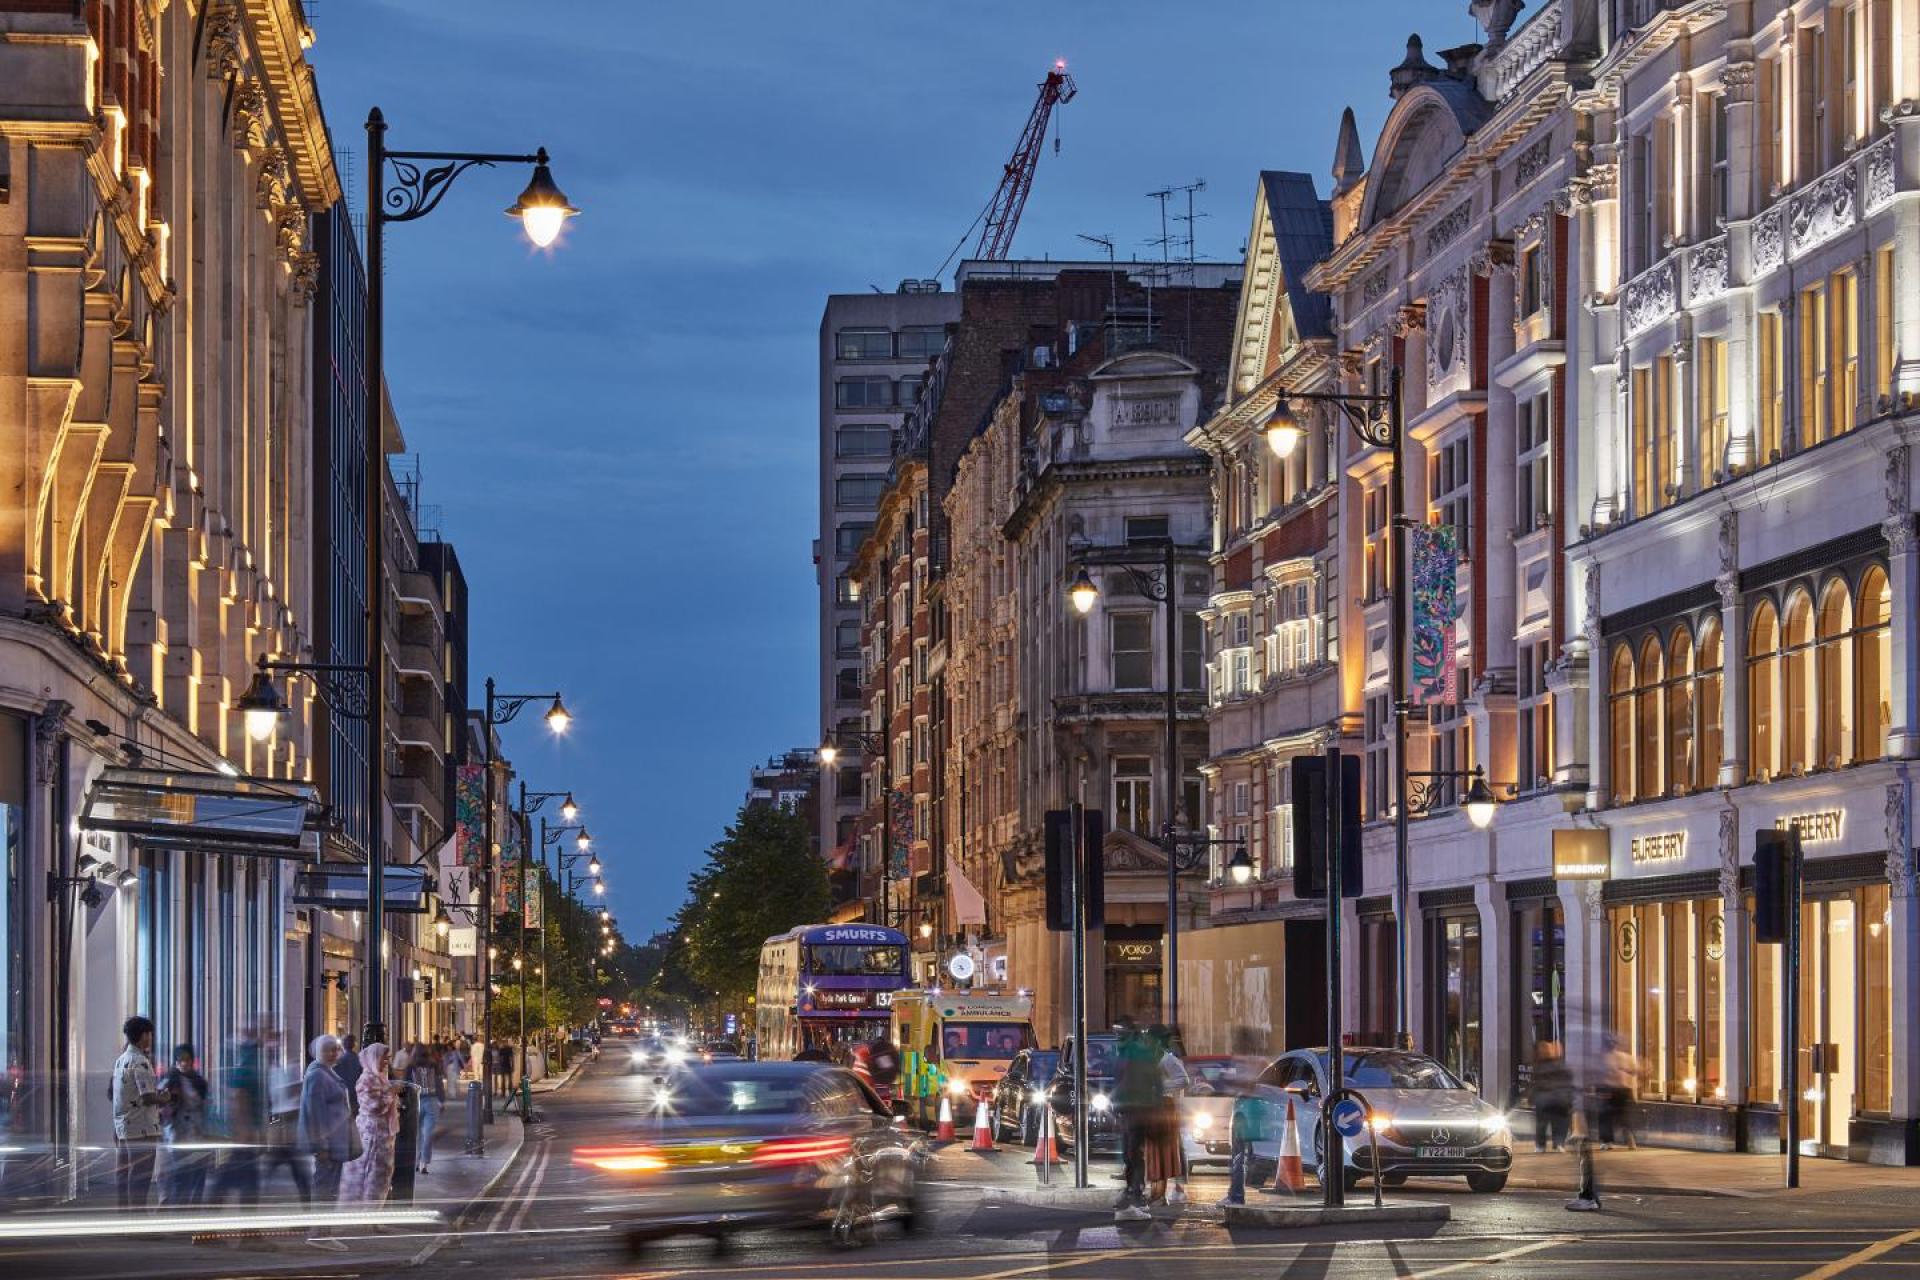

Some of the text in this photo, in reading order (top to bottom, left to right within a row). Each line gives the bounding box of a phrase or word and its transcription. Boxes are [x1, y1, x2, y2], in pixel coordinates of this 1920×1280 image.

[1446, 666, 1456, 702] Sloane
[1775, 810, 1842, 841] BERRY
[1632, 832, 1686, 862] BURBERRY
[825, 929, 887, 941] SMURFS
[1119, 944, 1153, 956] YOKO
[876, 992, 893, 1006] 137
[1423, 1147, 1446, 1157] FV22
